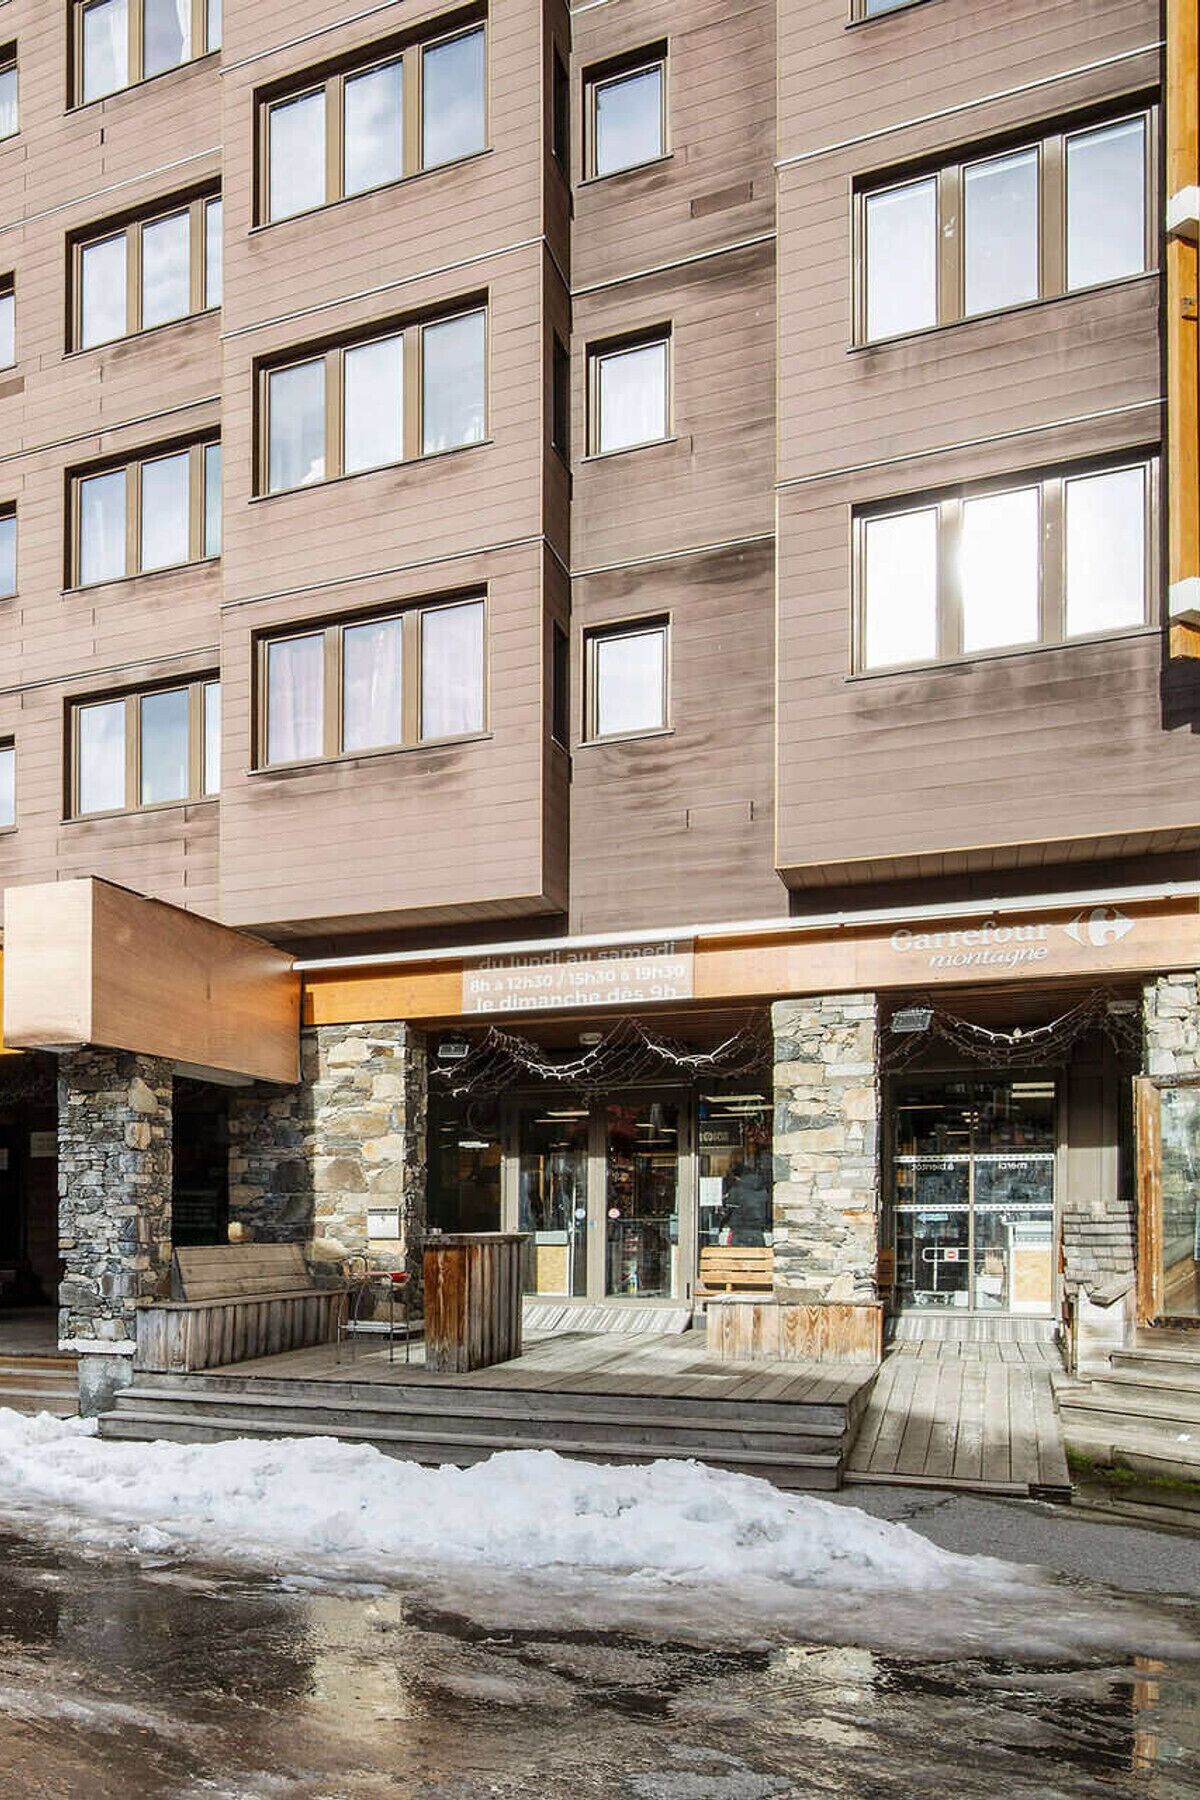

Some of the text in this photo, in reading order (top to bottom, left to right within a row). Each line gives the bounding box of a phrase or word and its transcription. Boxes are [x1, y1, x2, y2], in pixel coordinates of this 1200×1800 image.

[890, 921, 1048, 952] Carrefour
[478, 942, 676, 970] du lundi au samedi
[929, 946, 1048, 968] montagne
[470, 979, 490, 992] 8h
[508, 976, 553, 991] 12h30
[570, 970, 616, 987] 15h30
[635, 964, 686, 980] 19h30
[499, 989, 600, 1010] dimanche
[607, 986, 644, 1002] dès
[650, 985, 677, 999] 9h
